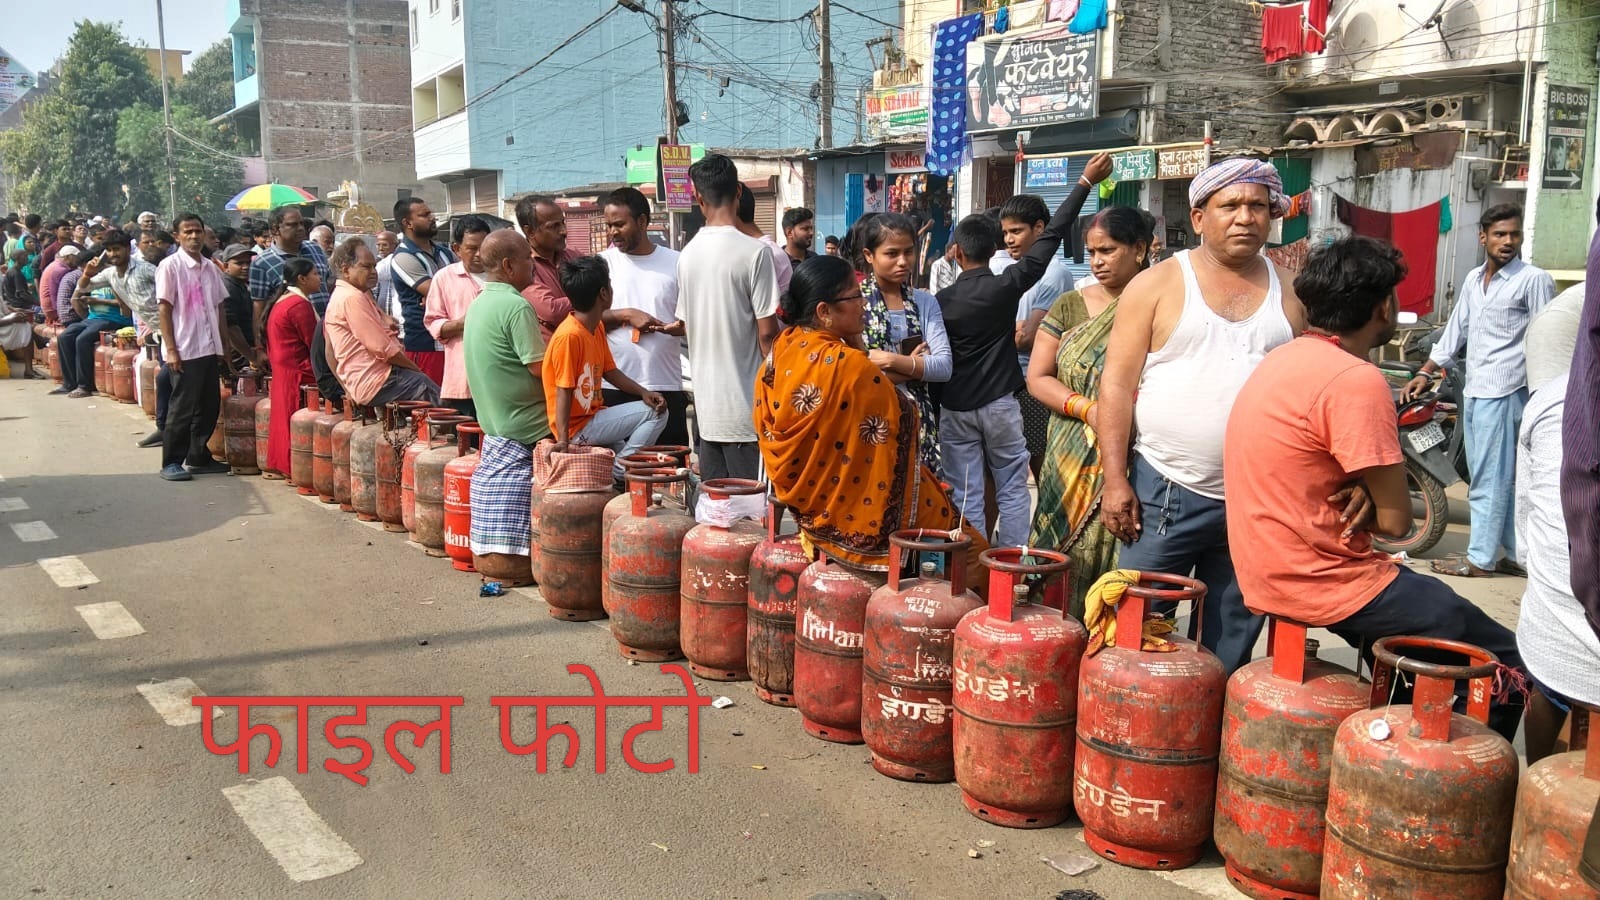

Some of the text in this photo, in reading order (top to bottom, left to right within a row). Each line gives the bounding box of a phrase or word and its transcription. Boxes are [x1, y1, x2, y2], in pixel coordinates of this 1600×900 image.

[1550, 91, 1588, 106] BIG BOSS
[663, 146, 690, 159] S.D.V.
[890, 152, 921, 169] Sudha
